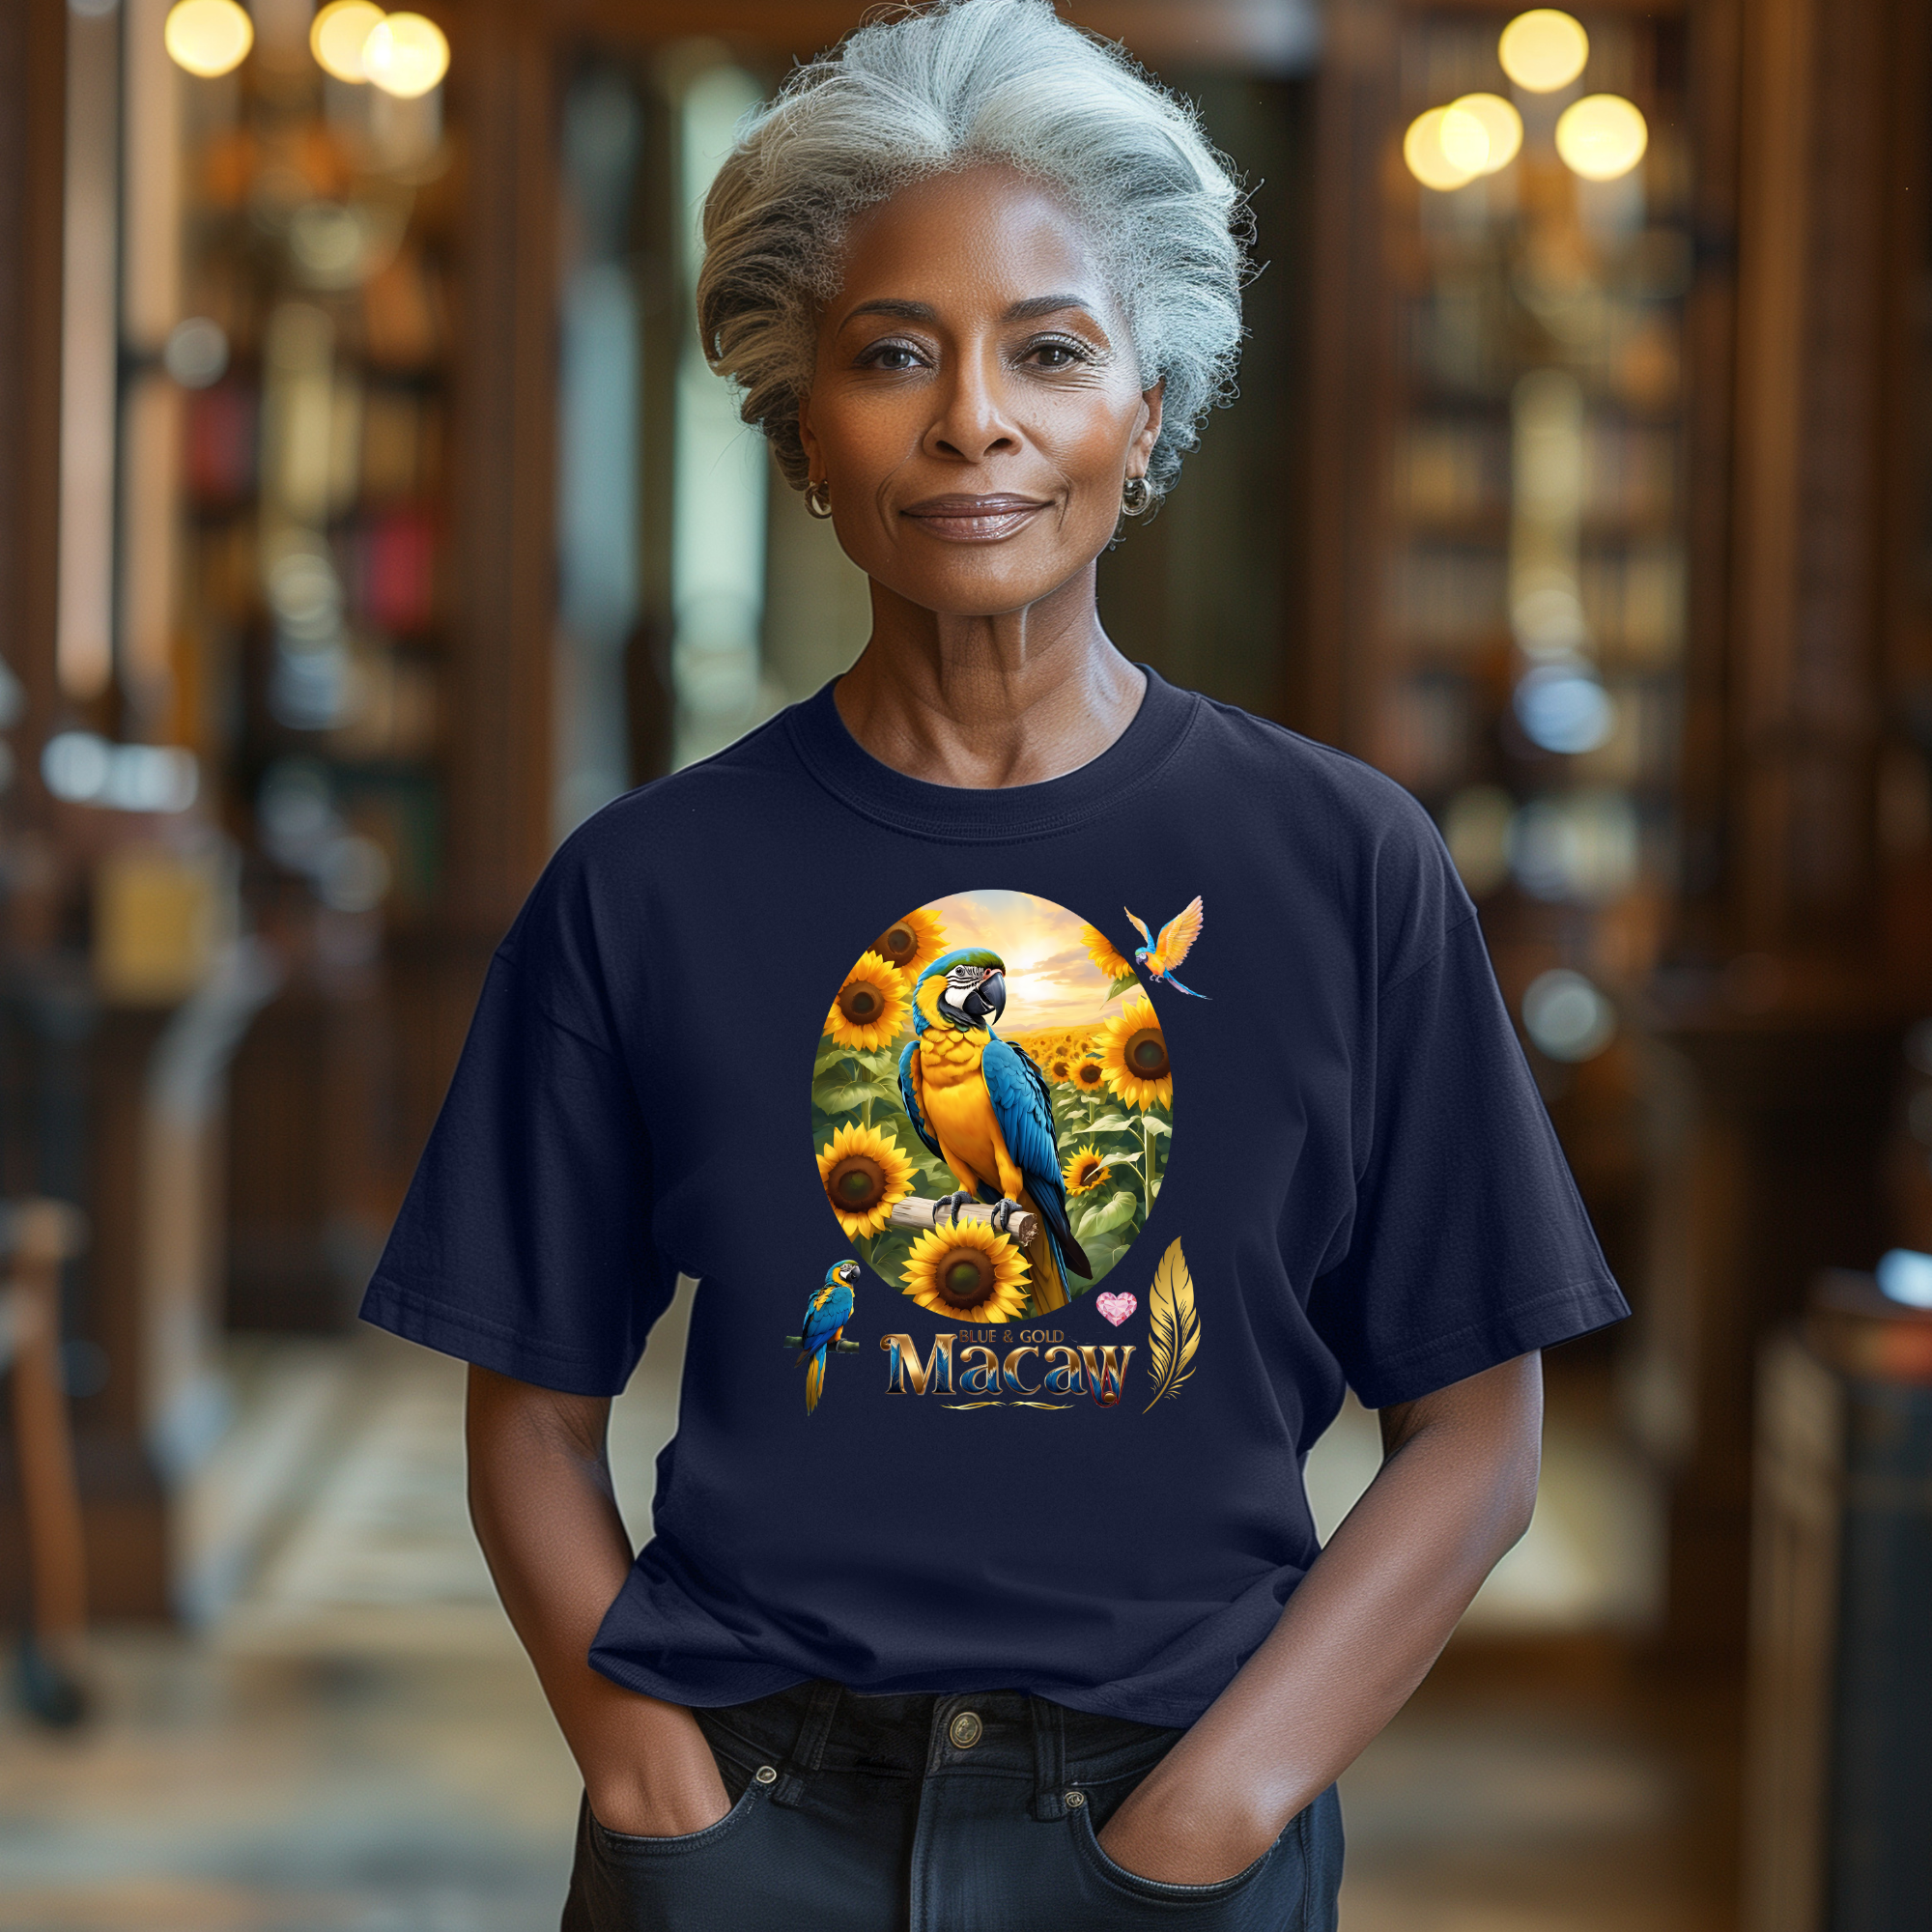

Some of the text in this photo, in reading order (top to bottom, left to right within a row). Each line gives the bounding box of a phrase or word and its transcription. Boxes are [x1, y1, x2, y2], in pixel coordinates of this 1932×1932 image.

[959, 1329, 1065, 1343] BLUE & GOLD
[879, 1333, 1137, 1407] Macaw
